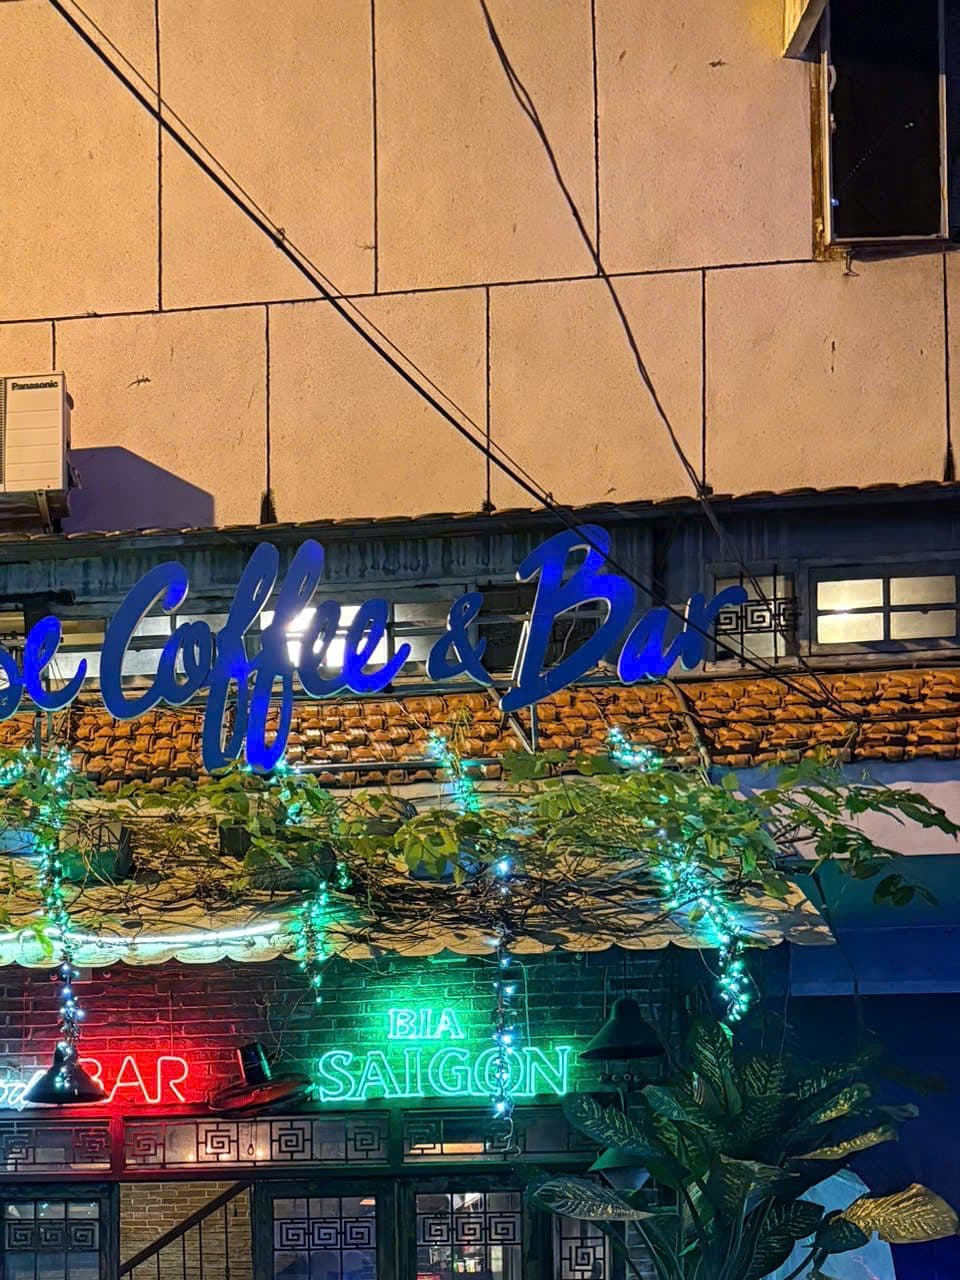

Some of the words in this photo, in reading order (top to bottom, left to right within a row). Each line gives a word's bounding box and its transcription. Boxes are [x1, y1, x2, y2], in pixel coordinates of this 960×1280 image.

[11, 380, 58, 390] Panasonic
[100, 539, 411, 773] Coffee
[427, 591, 493, 686] &
[499, 524, 748, 711] Bar
[388, 1008, 464, 1039] BIA
[318, 1046, 573, 1101] SAIGON
